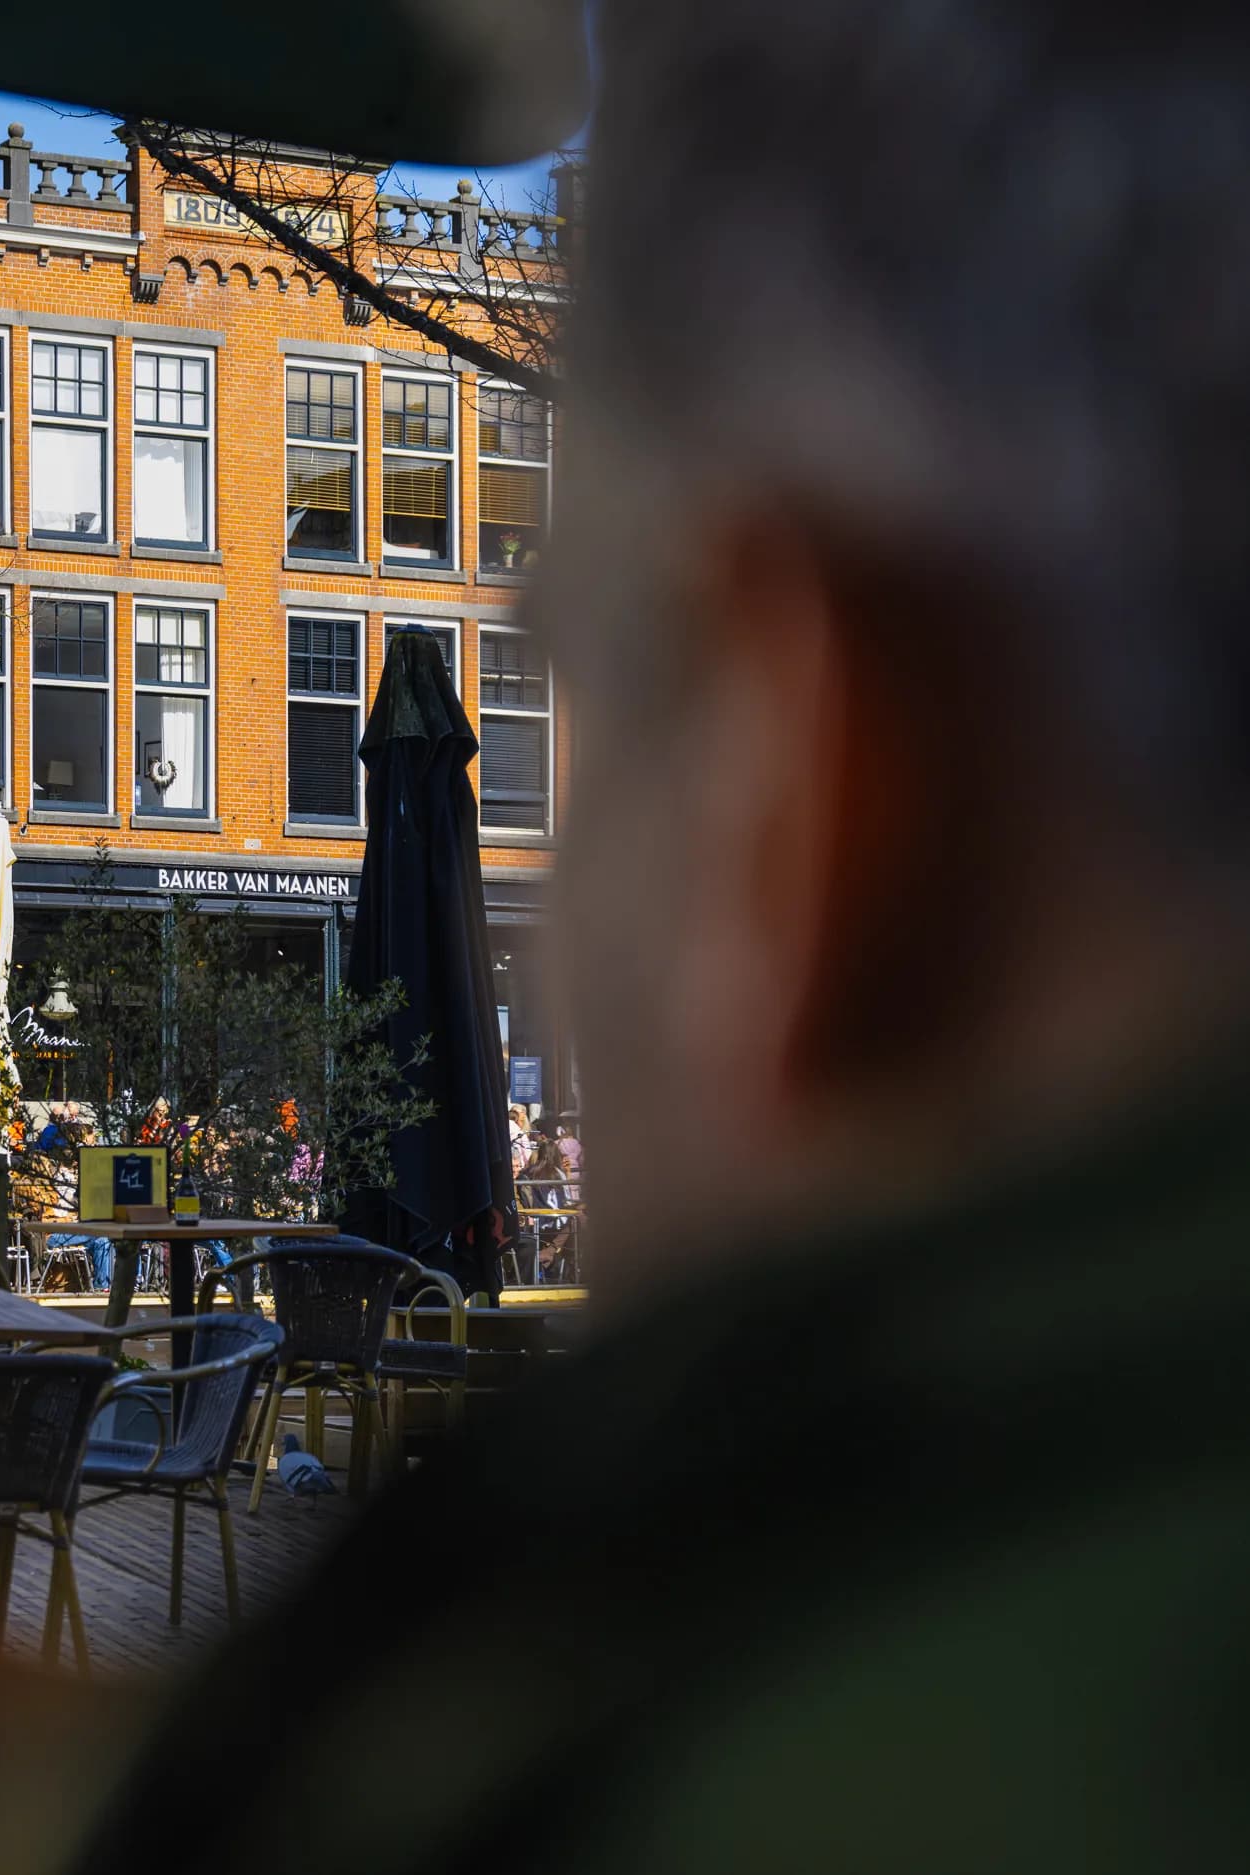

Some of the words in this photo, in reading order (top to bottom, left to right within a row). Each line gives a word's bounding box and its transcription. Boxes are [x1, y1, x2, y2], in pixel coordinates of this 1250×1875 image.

[158, 869, 228, 890] BAKKER
[234, 872, 269, 892] VAN
[276, 874, 349, 896] MAANEN
[119, 1168, 145, 1188] 41
